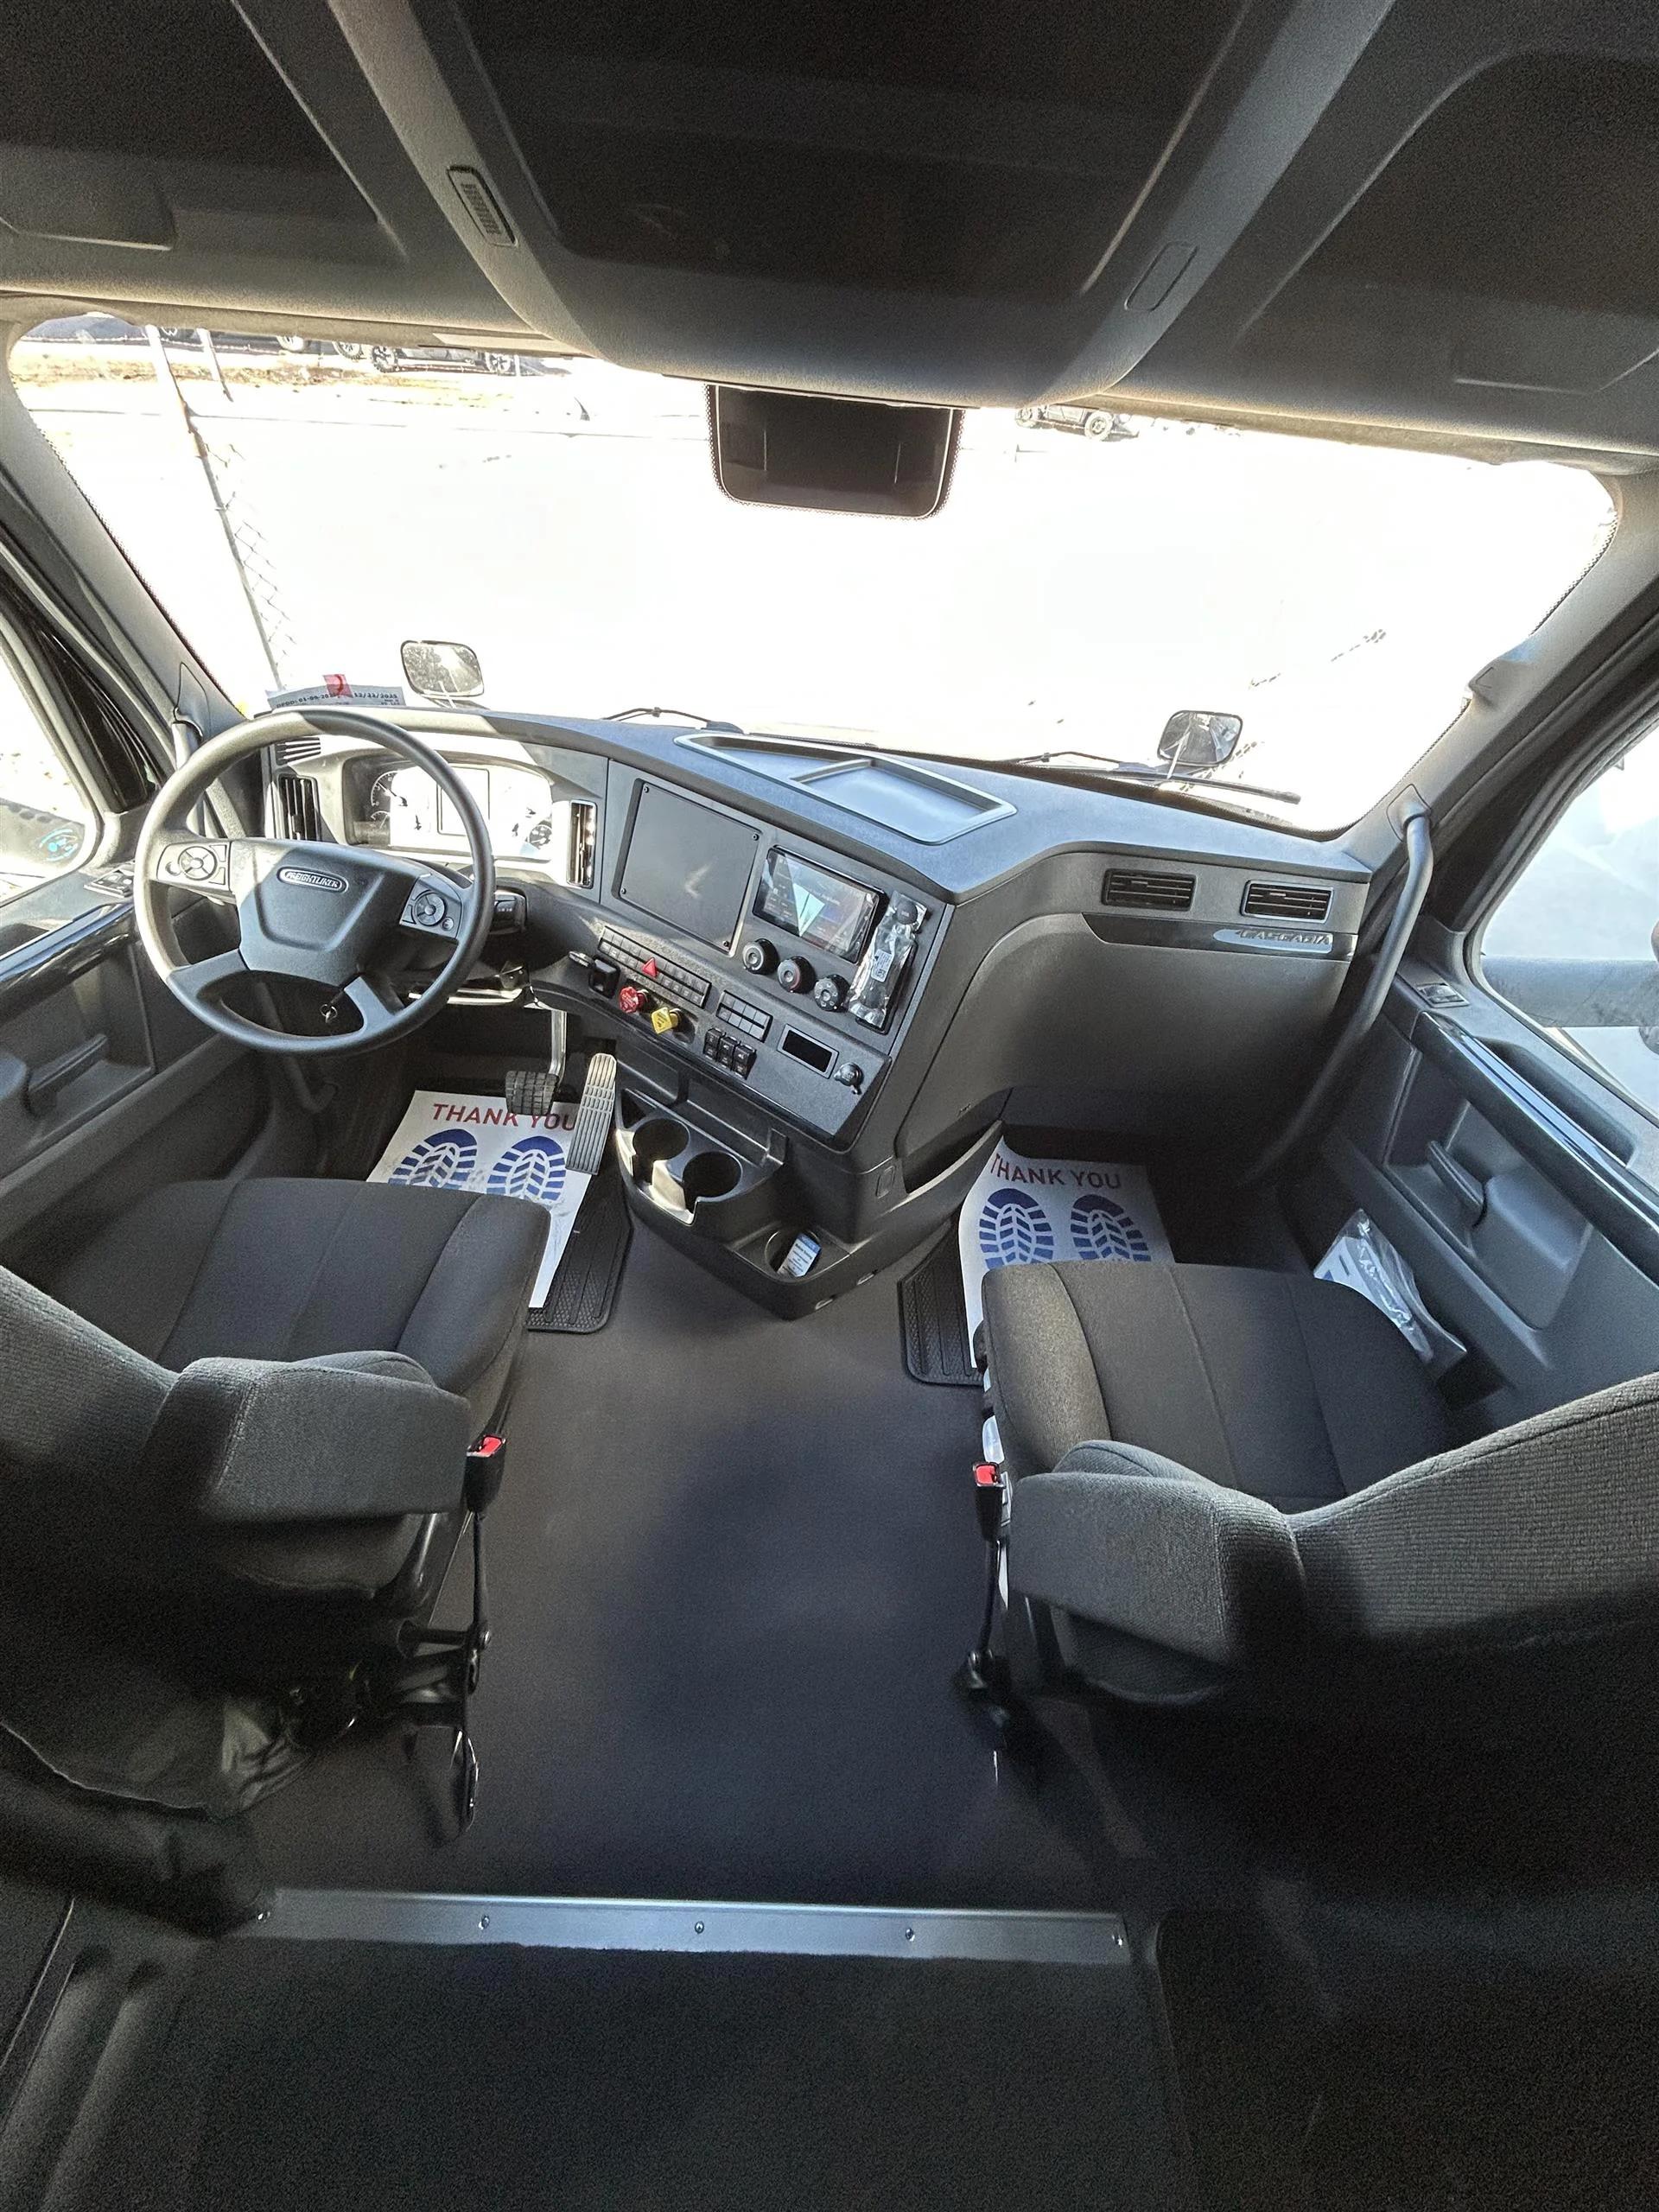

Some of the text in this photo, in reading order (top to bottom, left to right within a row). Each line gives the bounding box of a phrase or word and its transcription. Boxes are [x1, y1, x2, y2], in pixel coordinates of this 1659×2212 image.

[285, 871, 339, 888] FREIGHTLINER
[1239, 929, 1331, 944] CASCADIA
[433, 1103, 518, 1127] THANK
[990, 1153, 1122, 1190] THANK YOU
